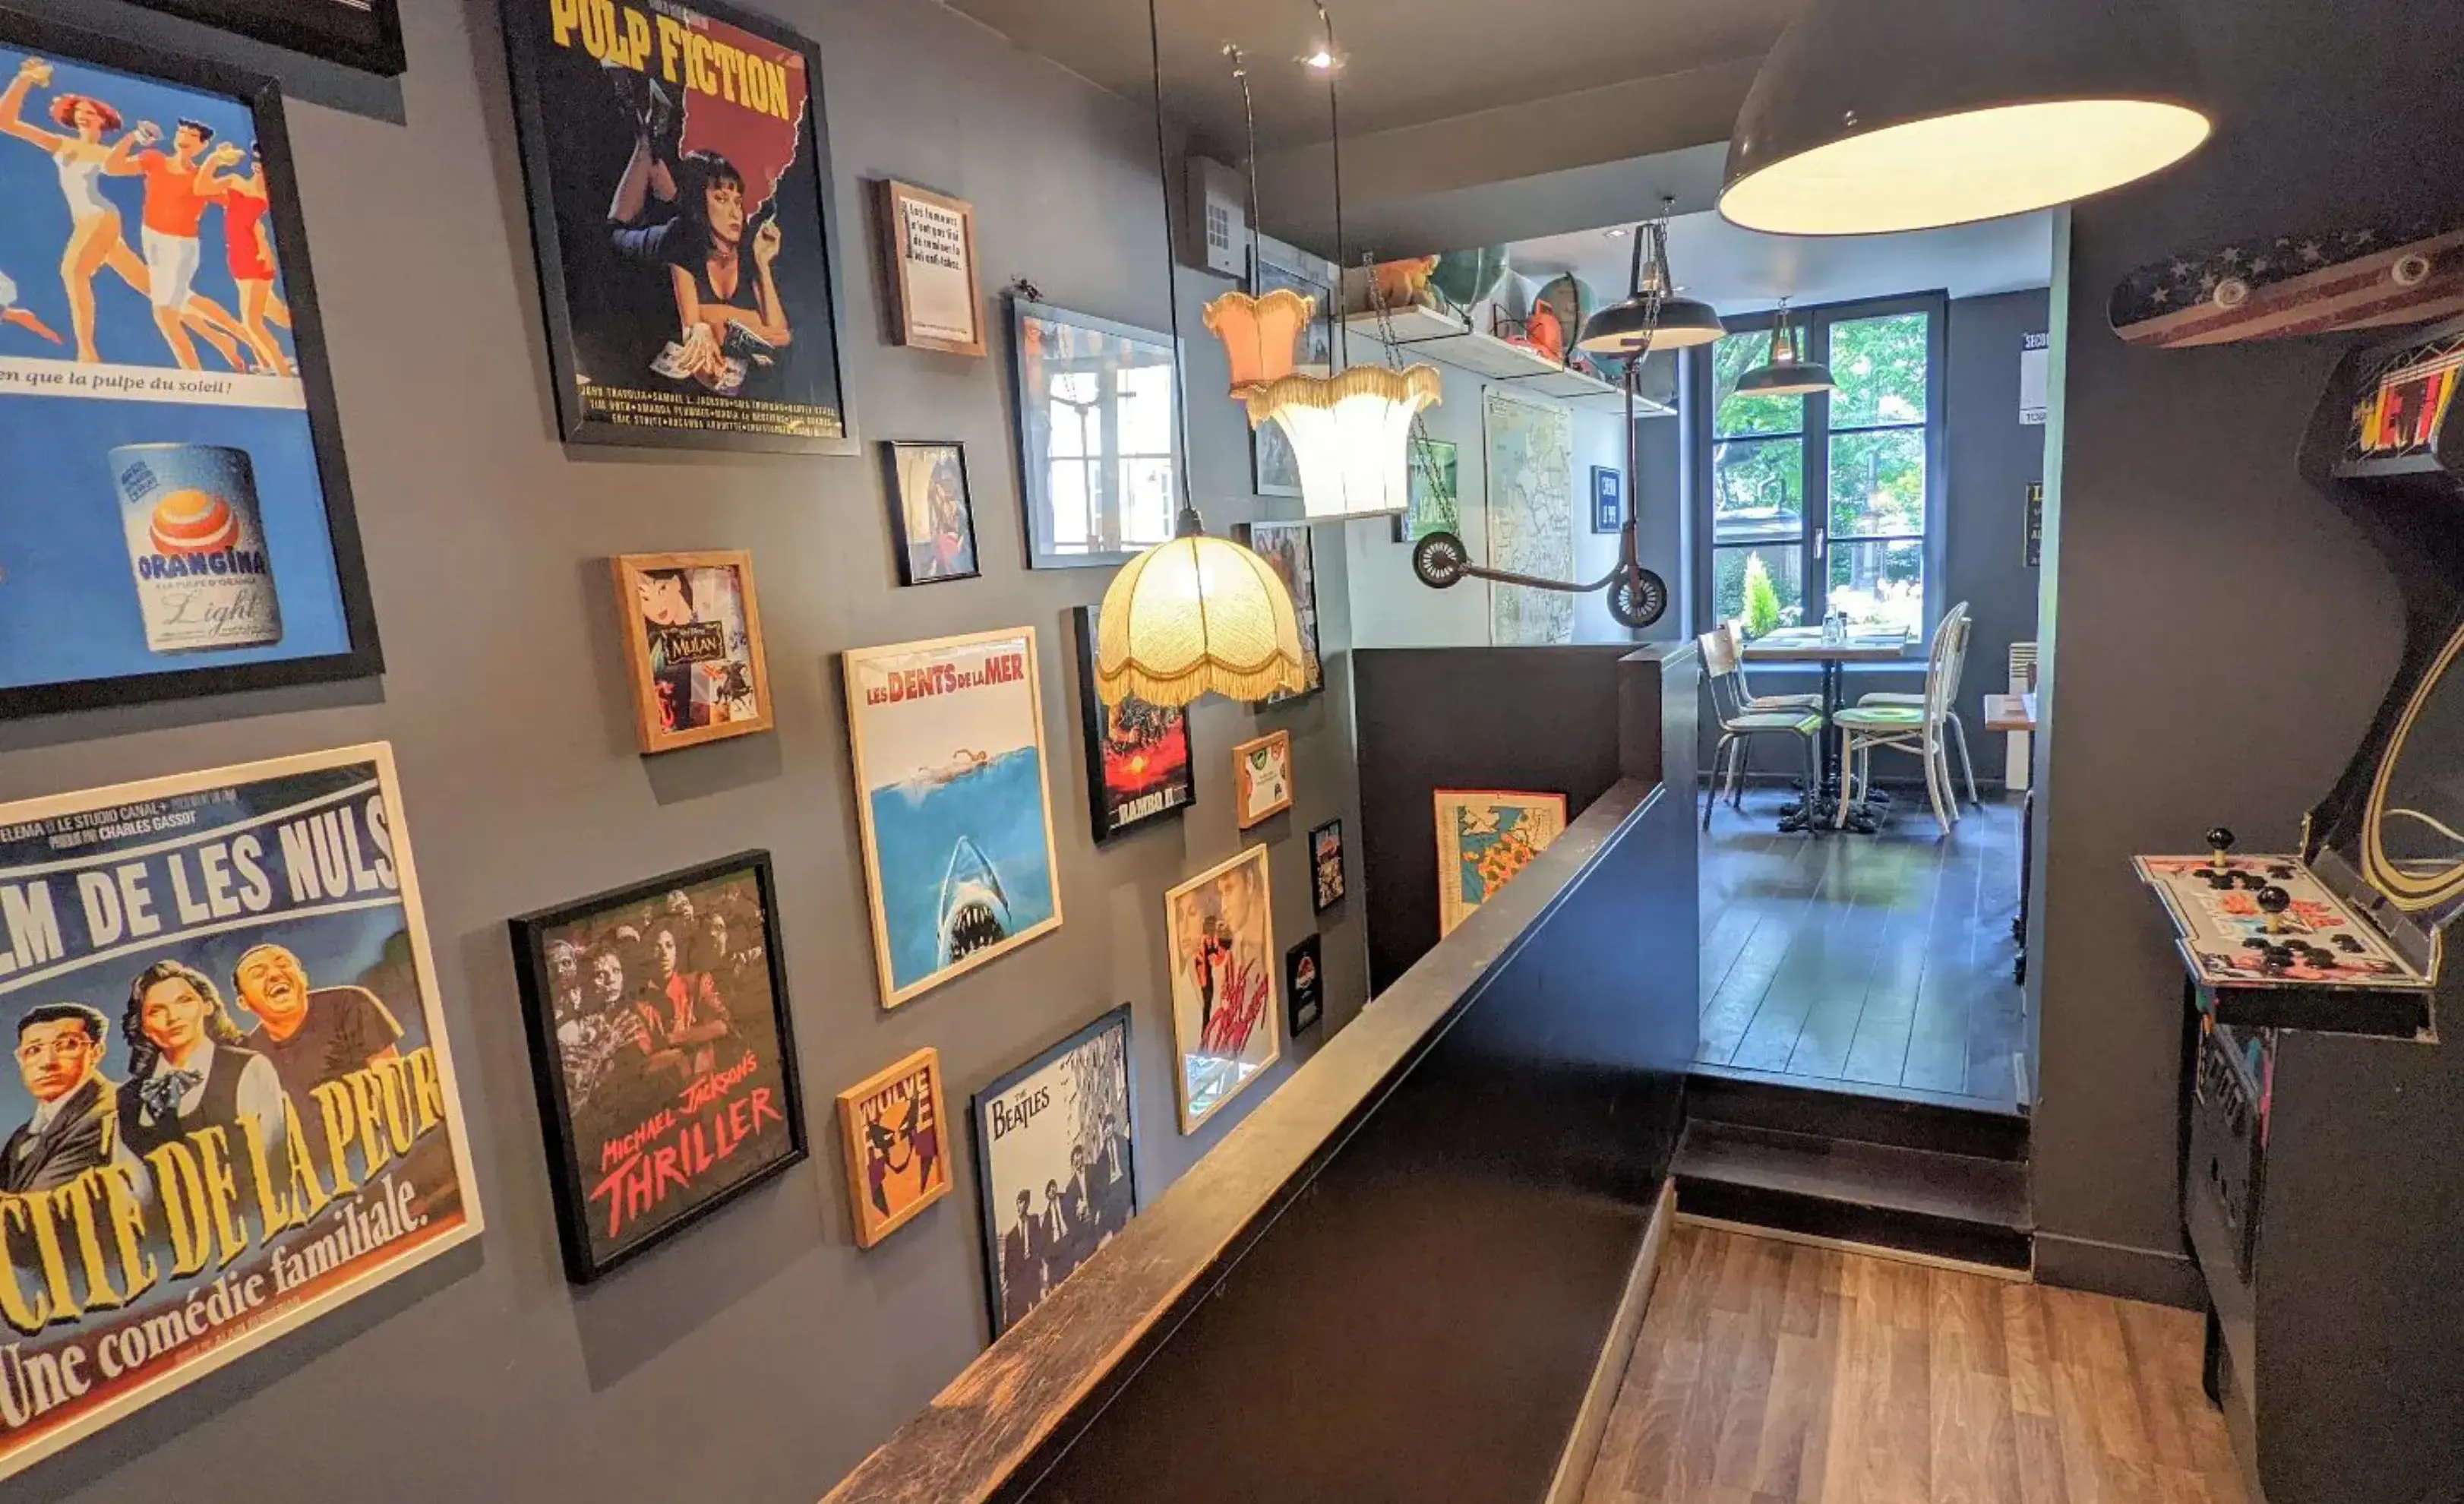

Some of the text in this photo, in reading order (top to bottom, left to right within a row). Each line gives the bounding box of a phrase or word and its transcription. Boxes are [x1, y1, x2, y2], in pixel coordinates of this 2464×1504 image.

[551, 0, 789, 120] PULP FICTION
[26, 371, 62, 386] que
[70, 371, 87, 385] la
[92, 374, 144, 390] pulpe
[150, 377, 173, 390] du
[138, 545, 267, 580] ORANGINA
[161, 588, 259, 638] Light
[867, 653, 1025, 706] LES DENTS DE LA MER
[58, 817, 73, 833] LE
[76, 807, 118, 827] STUDIO
[120, 801, 169, 821] CANAL+
[99, 816, 151, 841] CHARLES
[153, 810, 197, 831] GASSOT
[1119, 791, 1163, 826] RAMBO
[0, 794, 399, 975] M DE LES NULS
[602, 1108, 676, 1174] MICHAEL
[992, 1086, 1050, 1142] BEATLES
[151, 1125, 249, 1277] DE
[237, 1094, 330, 1239] LA
[311, 1047, 445, 1192] PEUR
[589, 1088, 783, 1238] THRILLER
[0, 1341, 91, 1427] Une
[99, 1269, 265, 1378] comédie
[270, 1174, 428, 1294] familiale.
